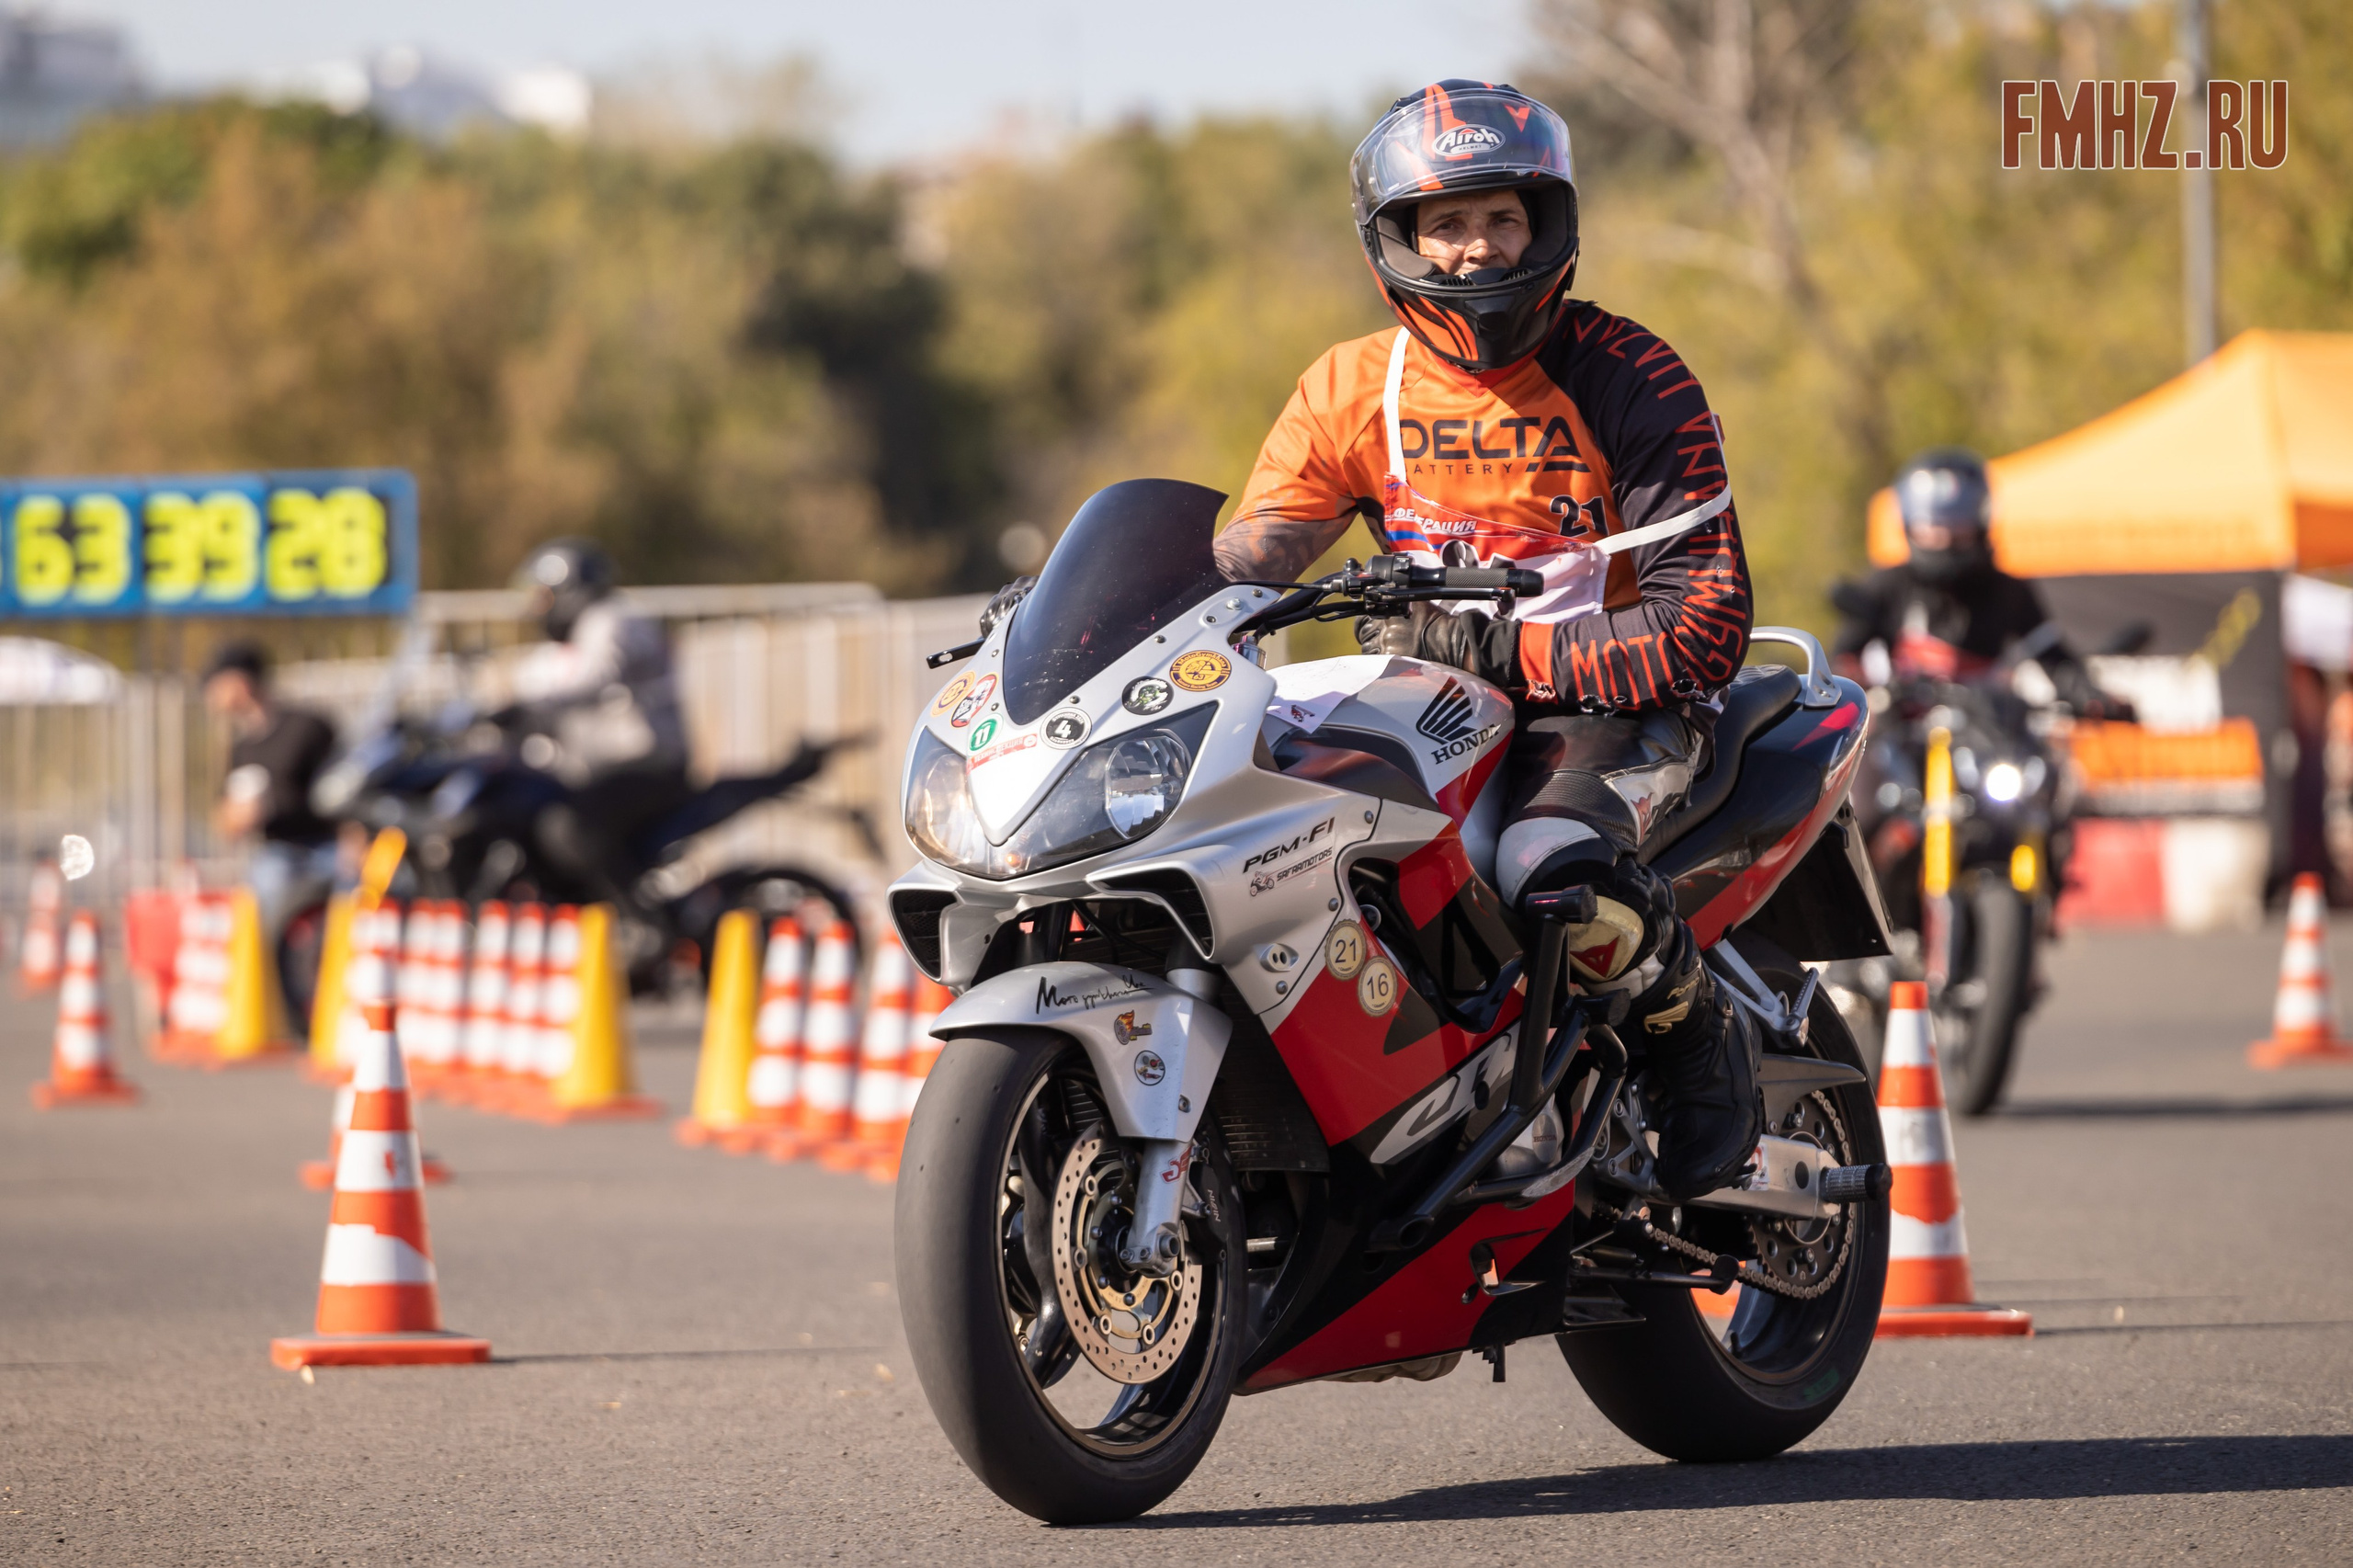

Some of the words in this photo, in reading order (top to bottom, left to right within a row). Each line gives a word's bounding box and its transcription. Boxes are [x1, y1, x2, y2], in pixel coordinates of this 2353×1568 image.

[1438, 128, 1501, 152] Airoh
[1398, 415, 1585, 460] DELTA
[1404, 462, 1514, 475] ATTERY
[1550, 494, 1609, 537] 21
[974, 723, 992, 746] 11
[1054, 720, 1072, 738] 4
[1430, 723, 1500, 765] HONDA
[1335, 938, 1357, 963] 21
[1367, 972, 1389, 1000] 16
